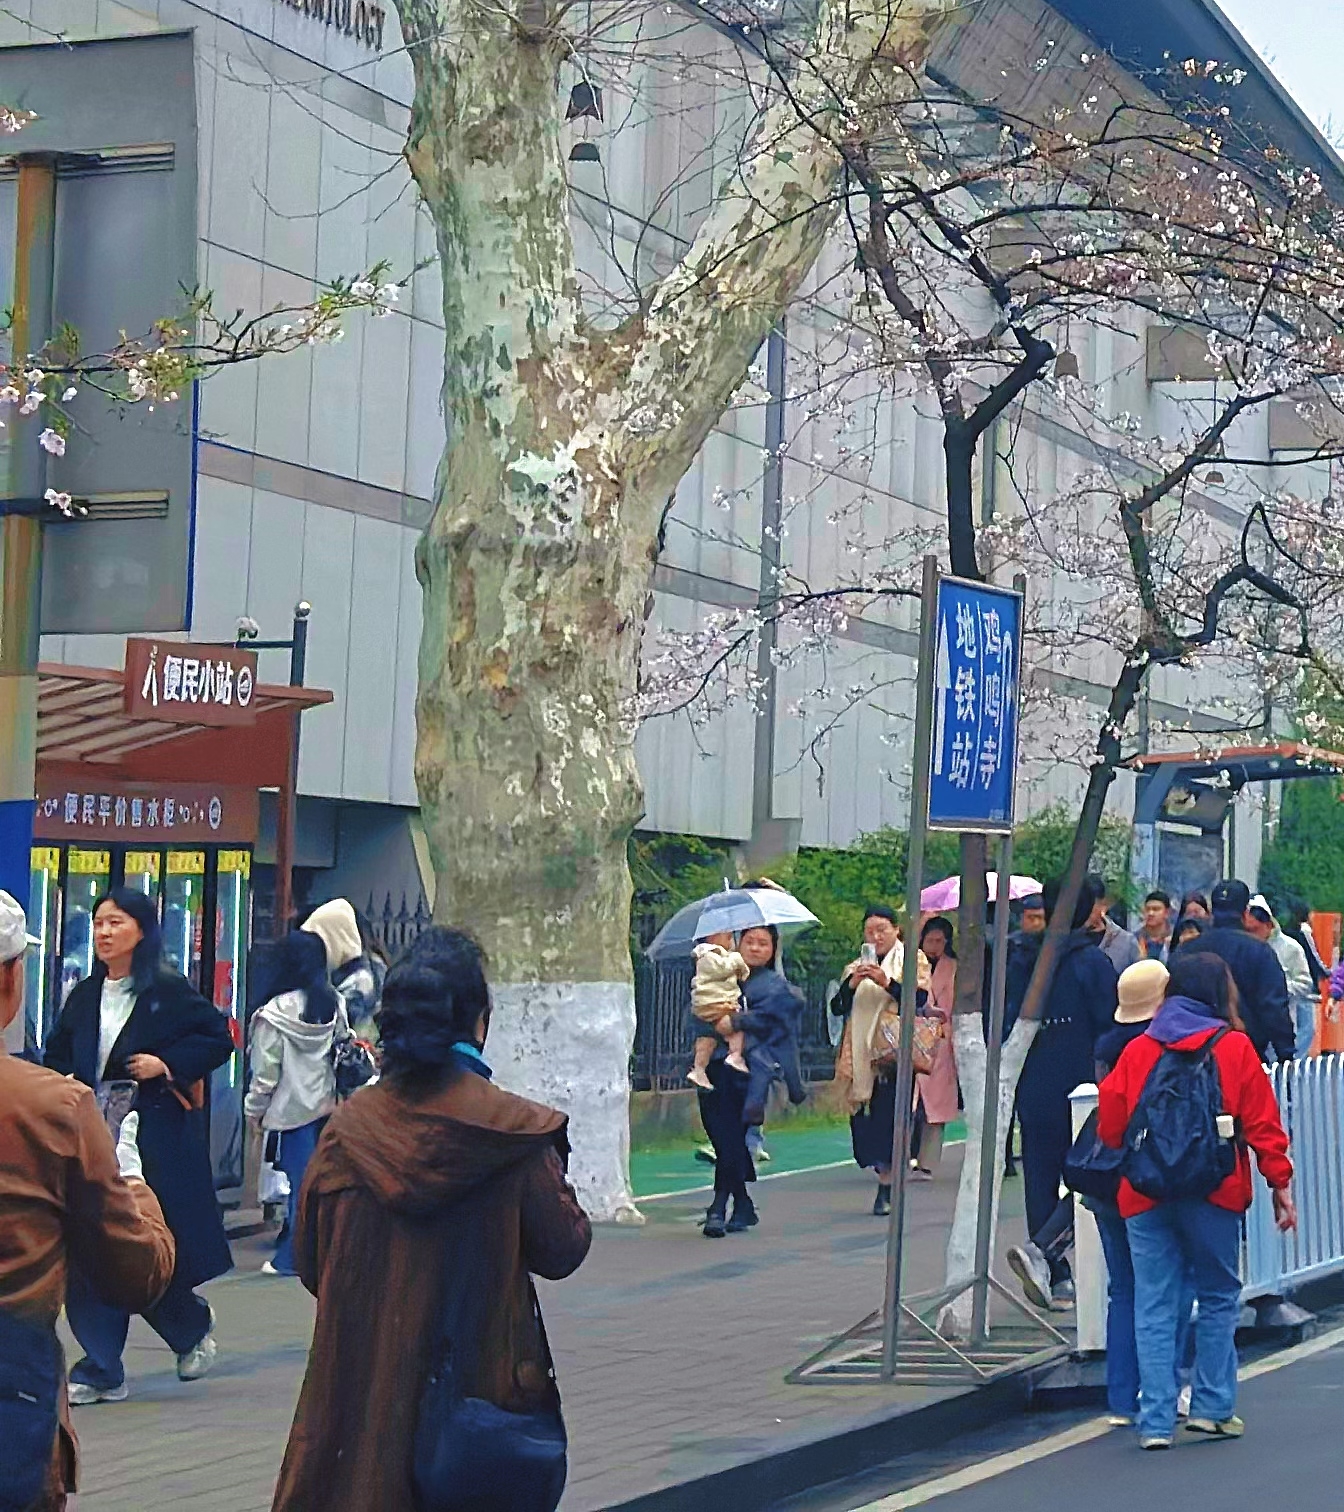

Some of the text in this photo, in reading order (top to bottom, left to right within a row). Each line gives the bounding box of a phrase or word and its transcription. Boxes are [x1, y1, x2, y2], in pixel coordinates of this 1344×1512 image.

[163, 654, 233, 706] 便民小站
[949, 601, 976, 789] 地铁站
[979, 608, 1002, 790] 鸡鸣寺
